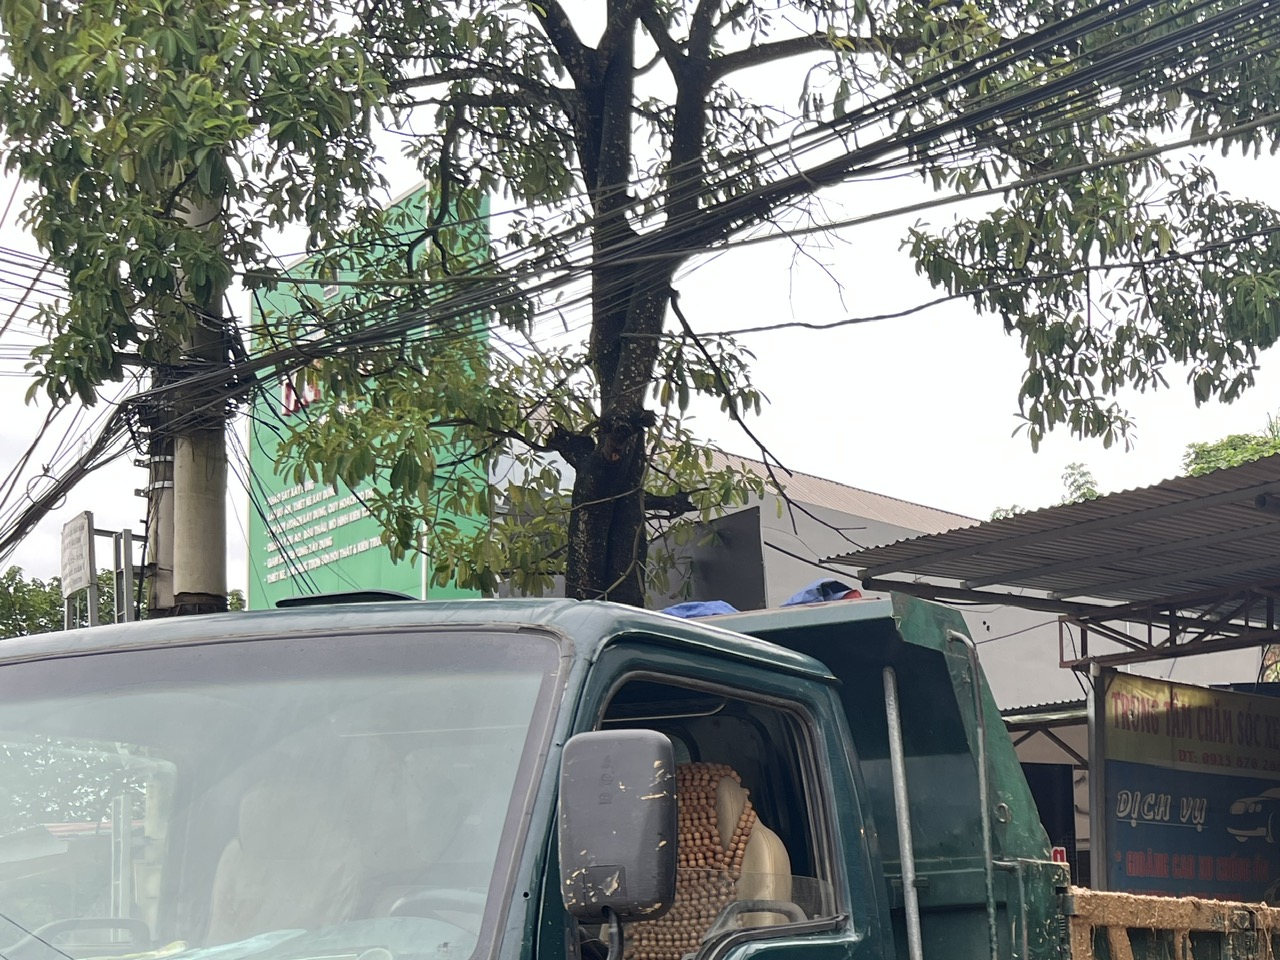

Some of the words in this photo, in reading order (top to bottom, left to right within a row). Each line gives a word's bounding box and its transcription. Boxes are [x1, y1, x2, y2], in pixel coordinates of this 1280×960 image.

[1111, 690, 1160, 736] TRUNG
[1164, 691, 1193, 741] TÂM
[1196, 697, 1234, 745] CHĂM
[1237, 702, 1263, 747] SÓC
[1116, 790, 1172, 828] DỊCH
[1179, 796, 1208, 832] VỤ
